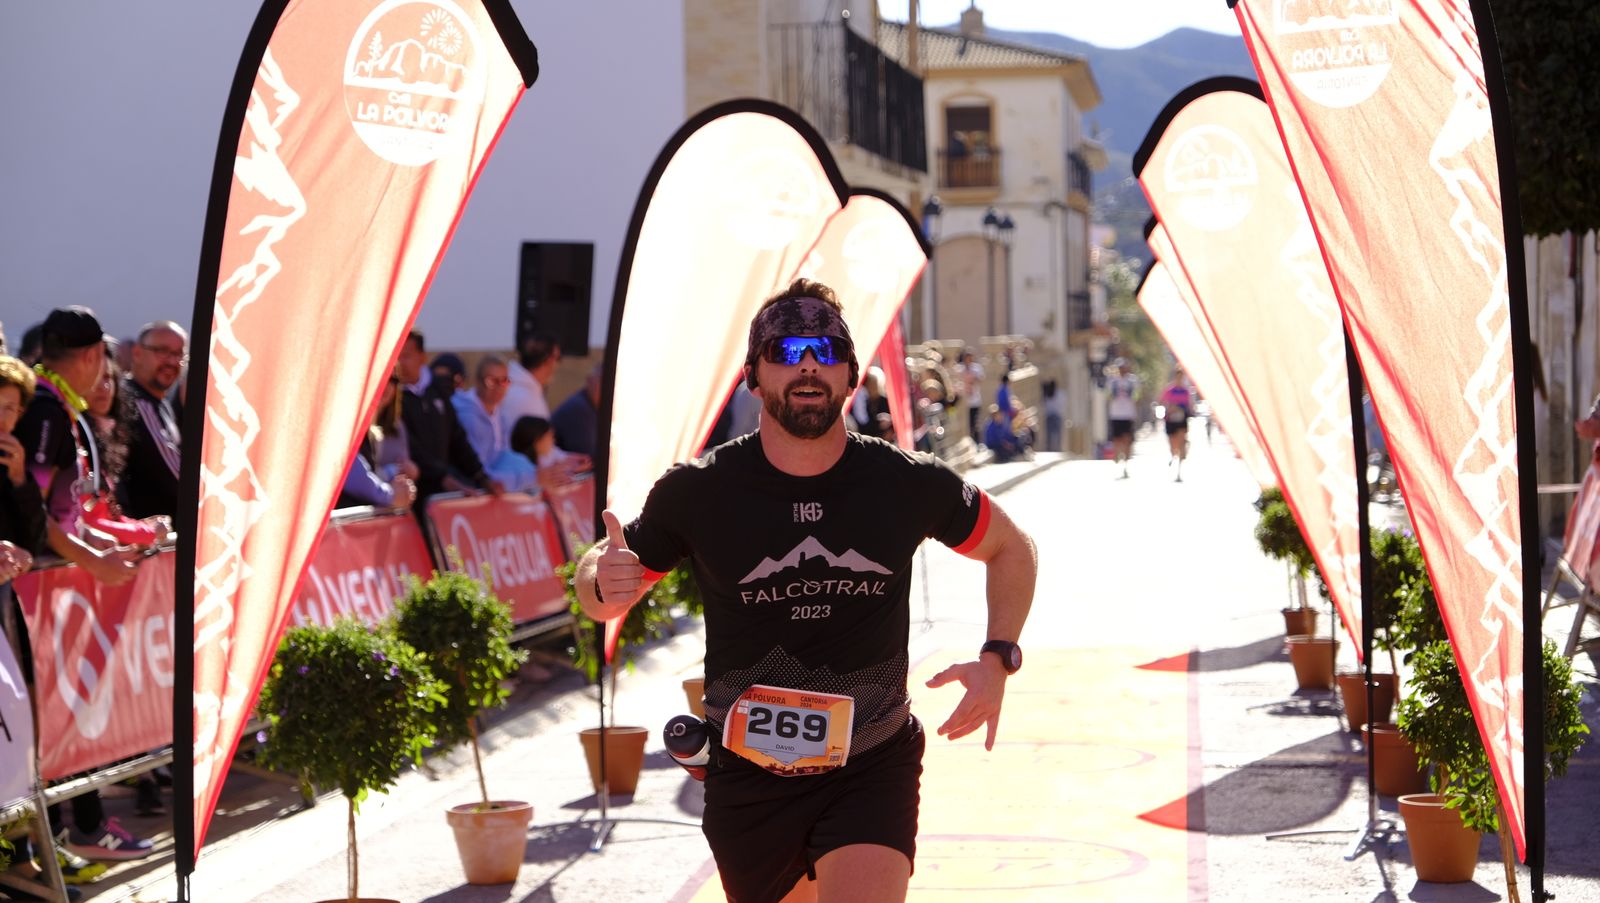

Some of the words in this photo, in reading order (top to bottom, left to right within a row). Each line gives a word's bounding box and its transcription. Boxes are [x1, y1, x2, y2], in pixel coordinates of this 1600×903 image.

[357, 101, 379, 121] LA
[479, 530, 553, 589] VEOLIA
[740, 580, 886, 604] FALCOTRAIL
[791, 604, 832, 620] 2023
[114, 611, 175, 694] VE
[748, 706, 827, 742] 269
[776, 744, 795, 752] DAVID
